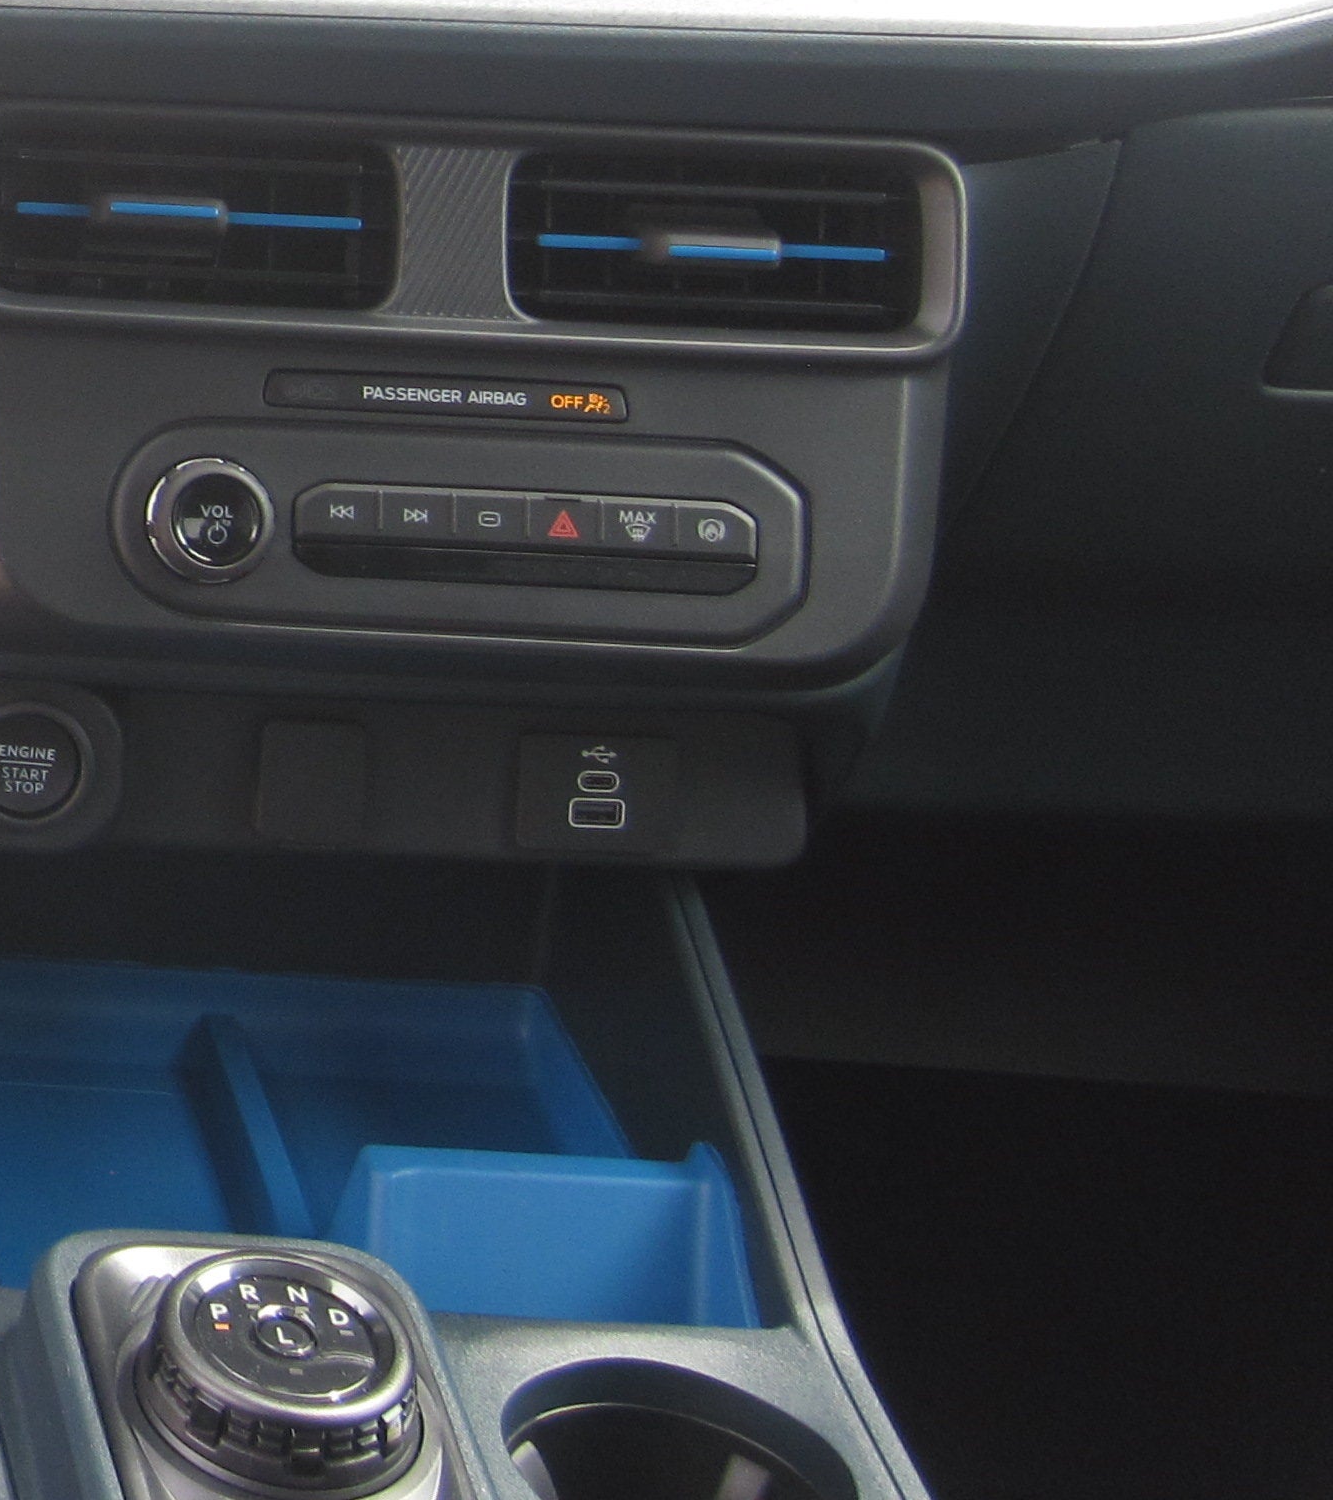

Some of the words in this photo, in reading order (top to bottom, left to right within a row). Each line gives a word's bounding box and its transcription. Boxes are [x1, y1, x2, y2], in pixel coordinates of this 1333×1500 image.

[362, 385, 462, 404] PASSENGER
[467, 389, 528, 407] AIRBAG
[550, 393, 584, 411] OFF
[199, 504, 233, 519] VOL
[618, 509, 657, 526] MAX
[1, 765, 49, 782] START
[4, 779, 44, 795] STOP
[238, 1283, 261, 1302] R
[285, 1284, 310, 1304] N
[209, 1302, 229, 1321] P
[327, 1307, 350, 1327] D
[275, 1326, 295, 1346] L
